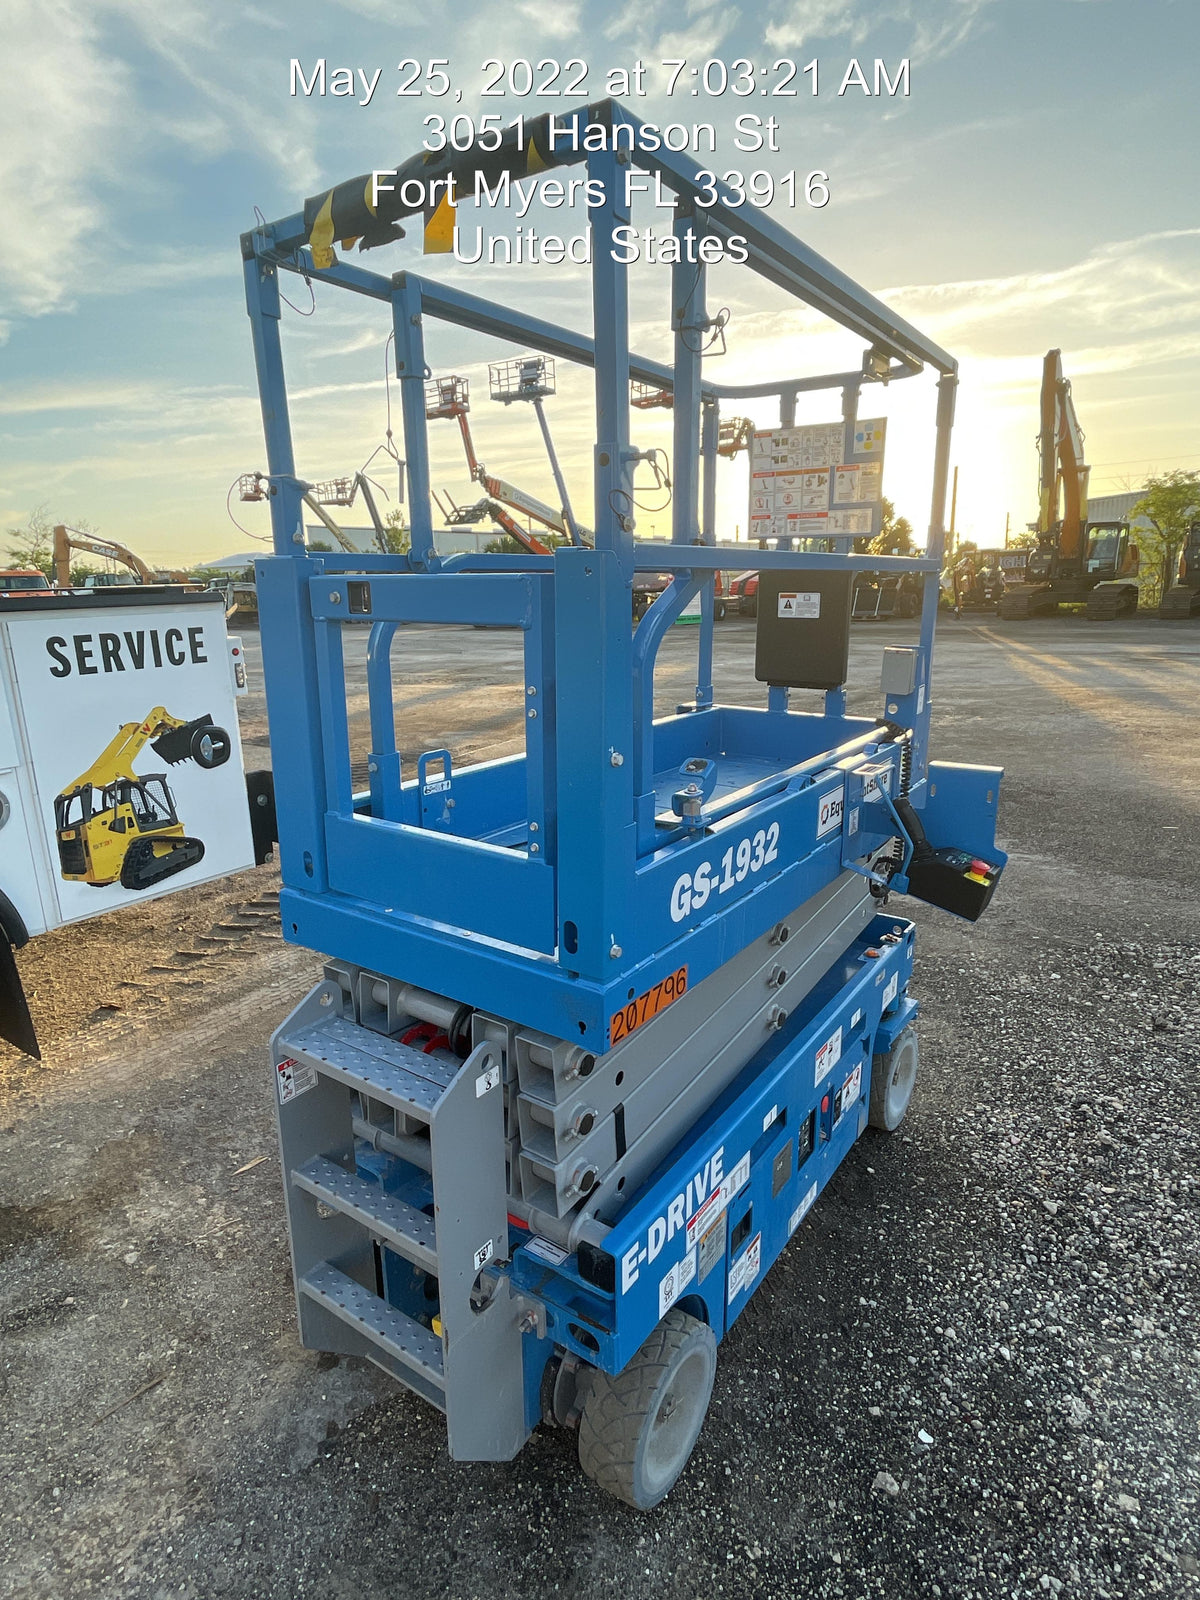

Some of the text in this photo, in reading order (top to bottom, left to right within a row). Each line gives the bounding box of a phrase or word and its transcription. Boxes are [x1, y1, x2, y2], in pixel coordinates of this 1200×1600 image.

[91, 544, 119, 558] CASE
[45, 626, 208, 678] SERVICE
[670, 821, 780, 923] GS-1932
[612, 967, 687, 1045] 207796
[621, 1145, 724, 1296] E-DRIVE
